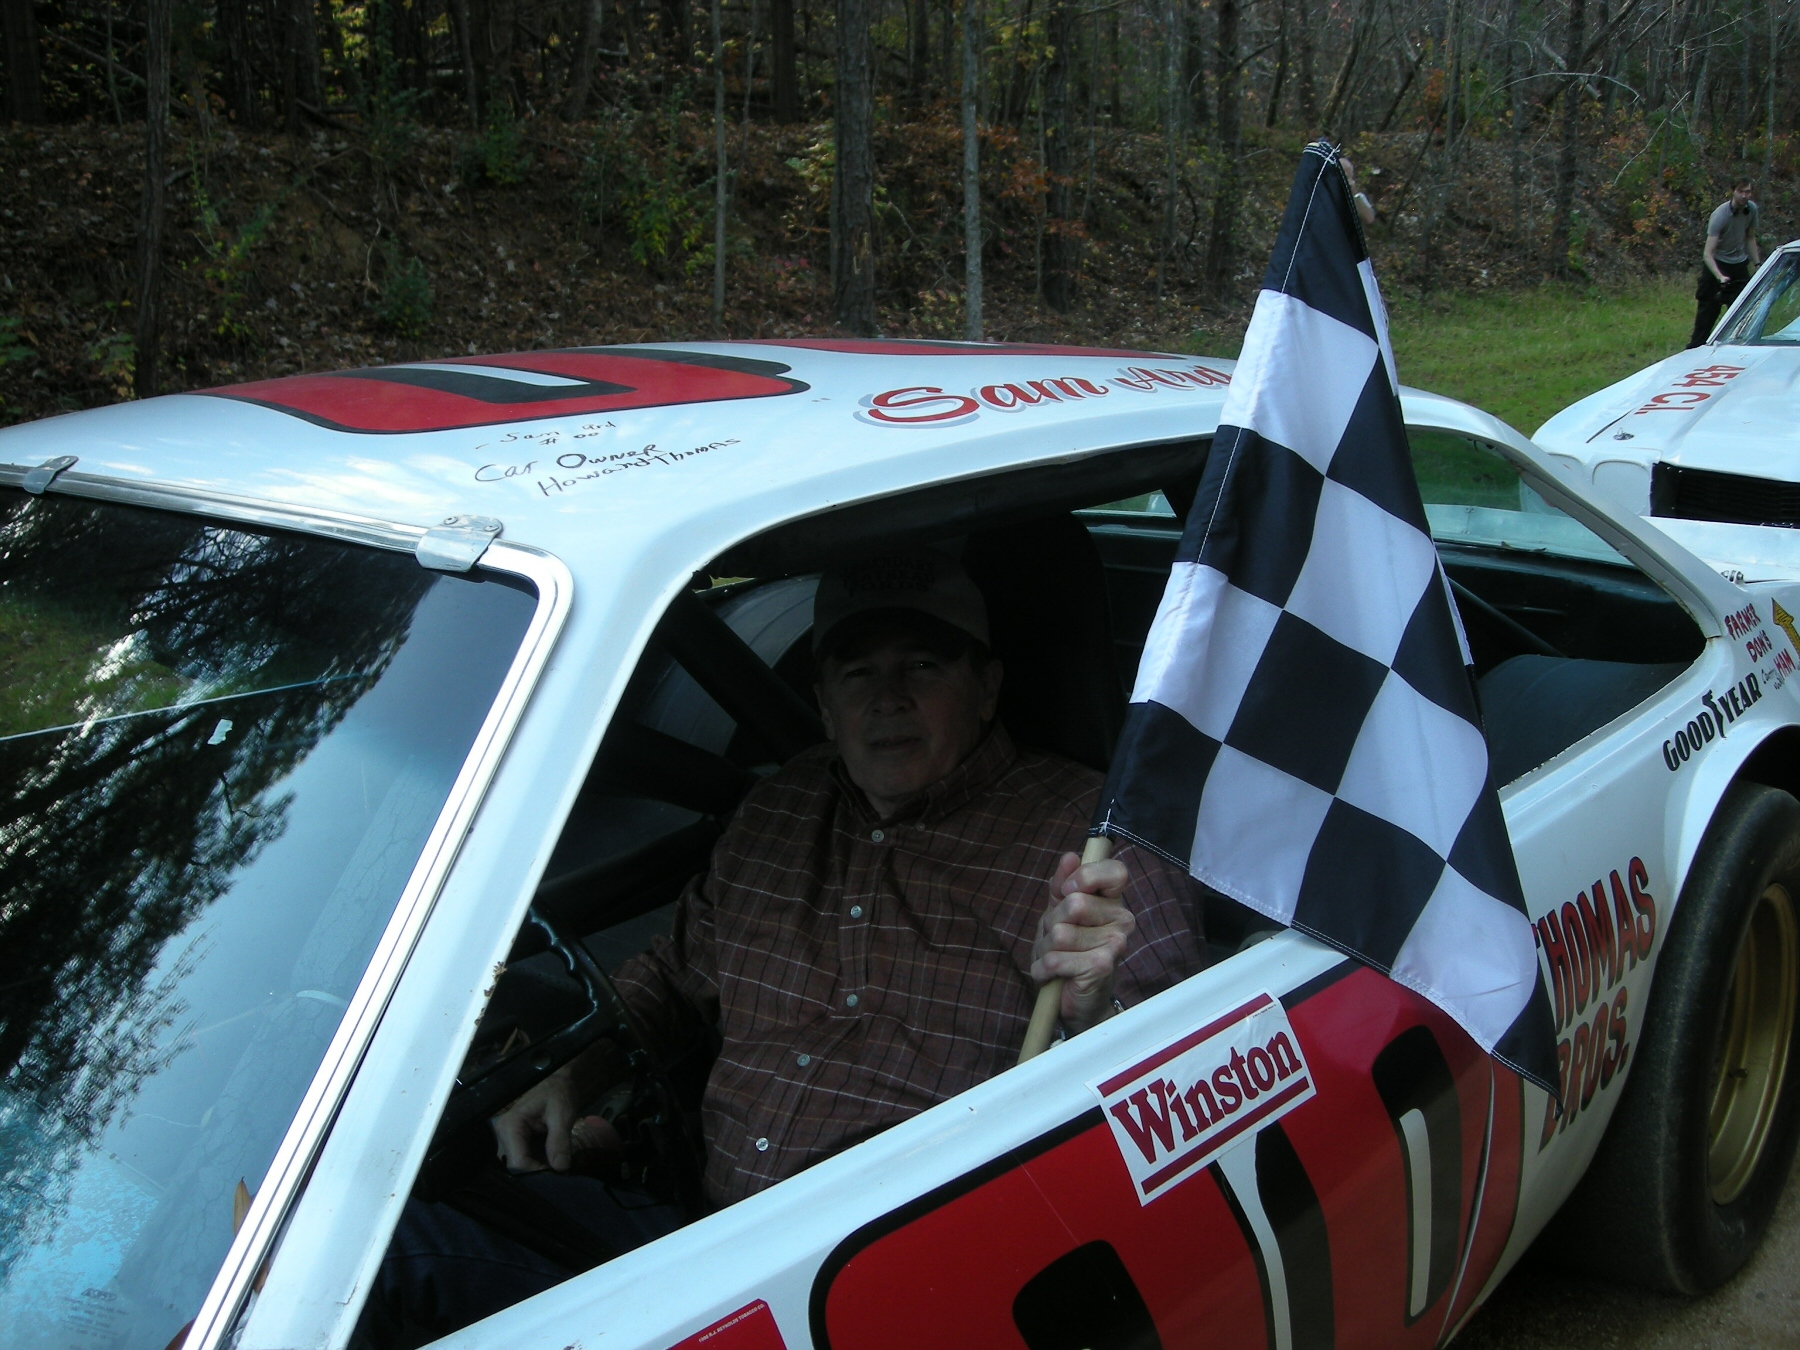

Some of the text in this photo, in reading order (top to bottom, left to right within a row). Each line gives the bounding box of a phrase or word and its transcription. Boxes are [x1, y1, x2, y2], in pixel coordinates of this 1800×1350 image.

[853, 376, 1110, 429] Sam
[1671, 364, 1746, 388] 454
[474, 460, 539, 482] Car
[1773, 647, 1797, 680] HAM
[1662, 672, 1763, 772] GOODYEAR
[1531, 856, 1656, 1037] HOMAS
[1108, 1030, 1303, 1165] Winston
